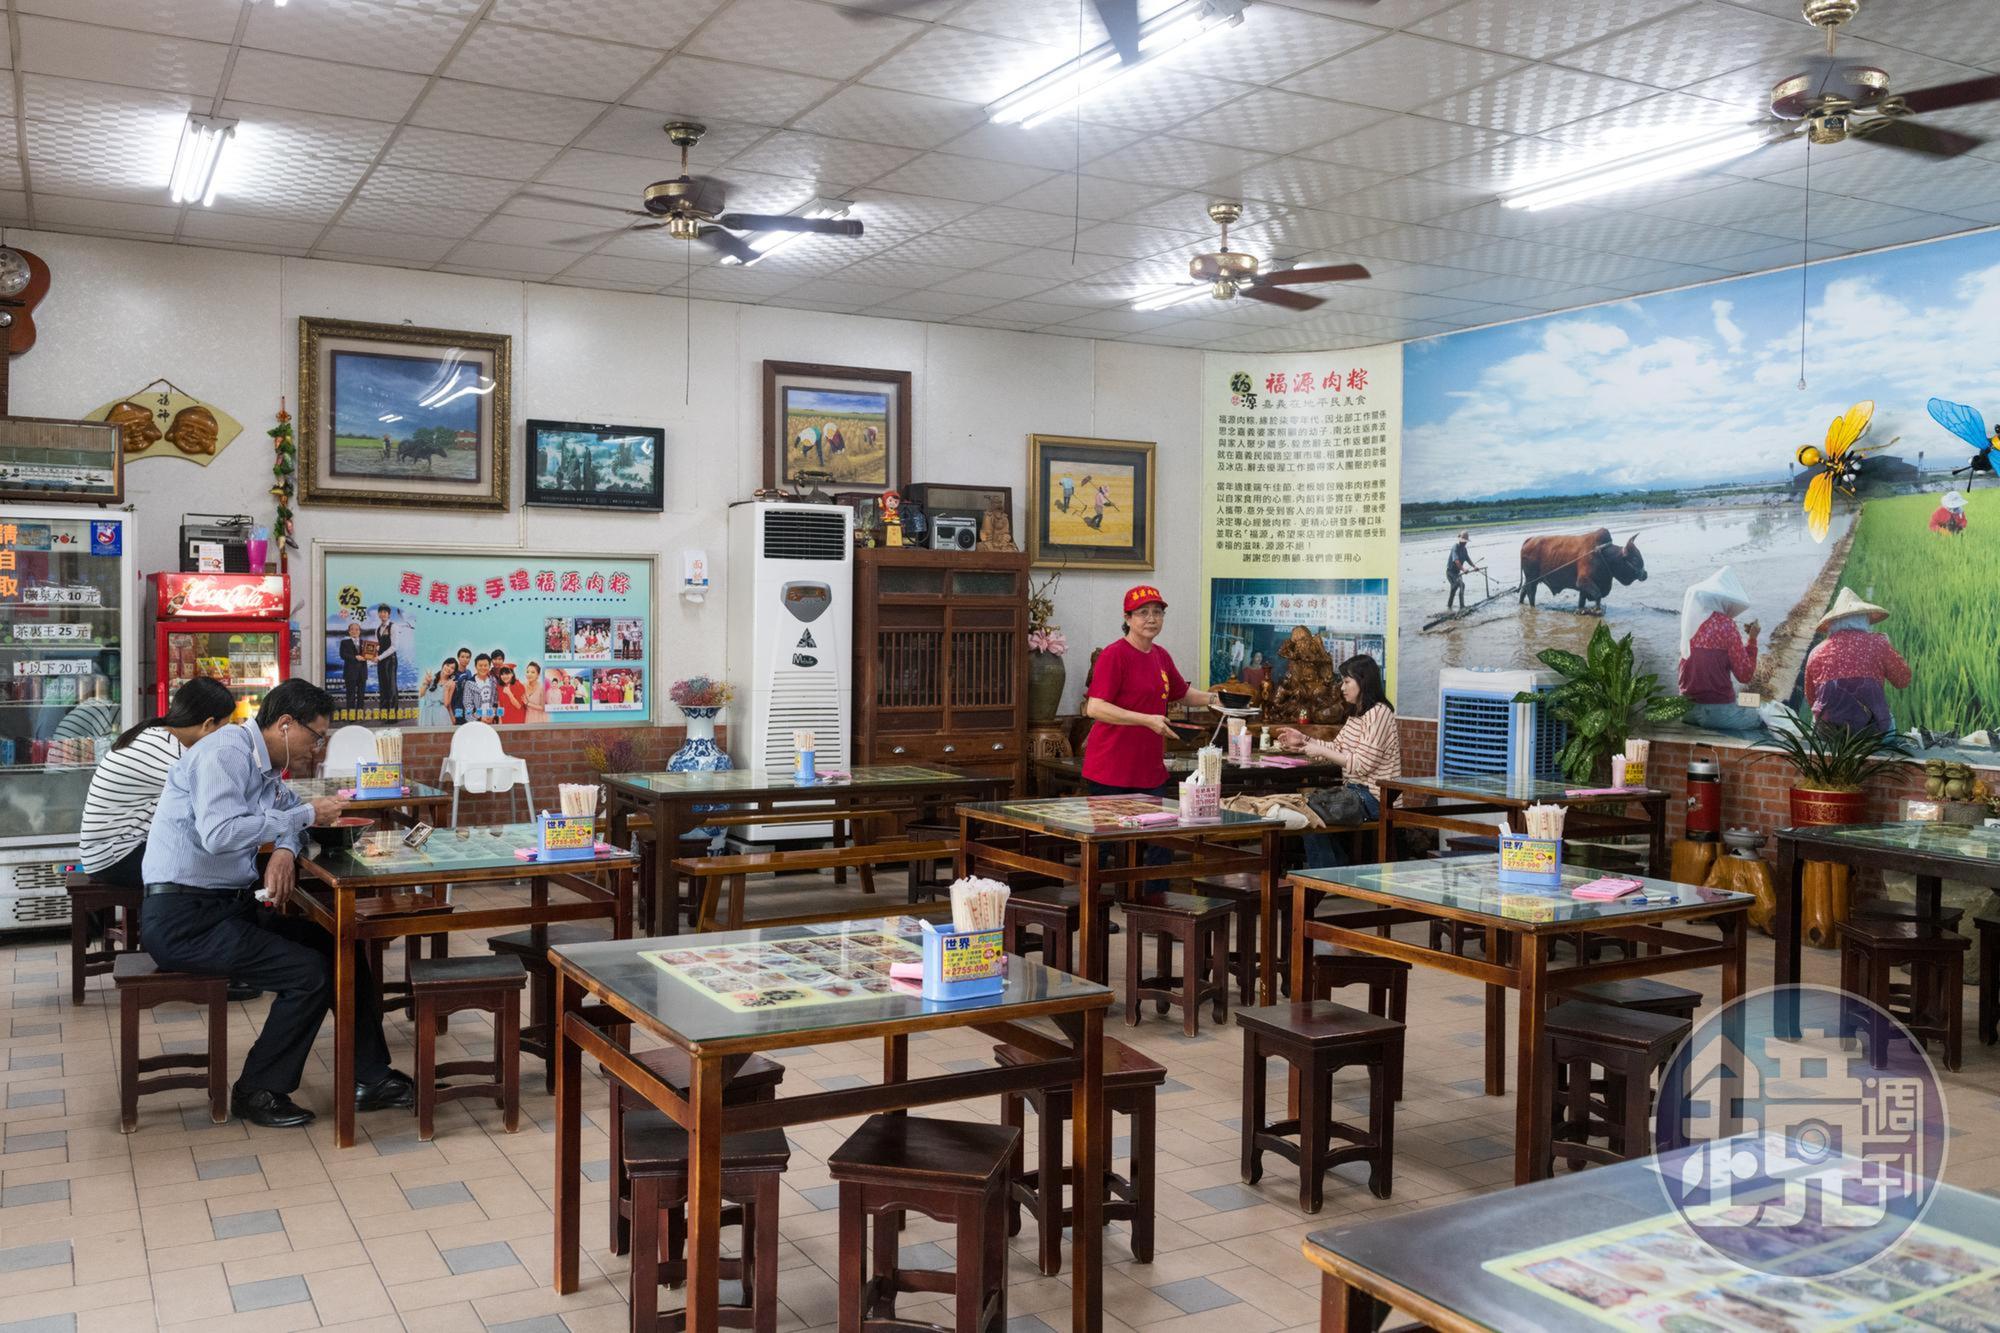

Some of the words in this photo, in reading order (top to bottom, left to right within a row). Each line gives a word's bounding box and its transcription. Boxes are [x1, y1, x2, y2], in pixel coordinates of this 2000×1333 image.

[1266, 368, 1369, 395] 福源肉粽
[1262, 395, 1367, 410] 嘉義在地平民美食
[69, 592, 82, 601] 10
[86, 590, 99, 602] 元
[58, 627, 72, 636] 25
[76, 626, 88, 638] 元
[29, 663, 57, 675] 以下
[59, 664, 72, 674] 20
[75, 662, 88, 674] 元
[944, 937, 970, 951] 世界
